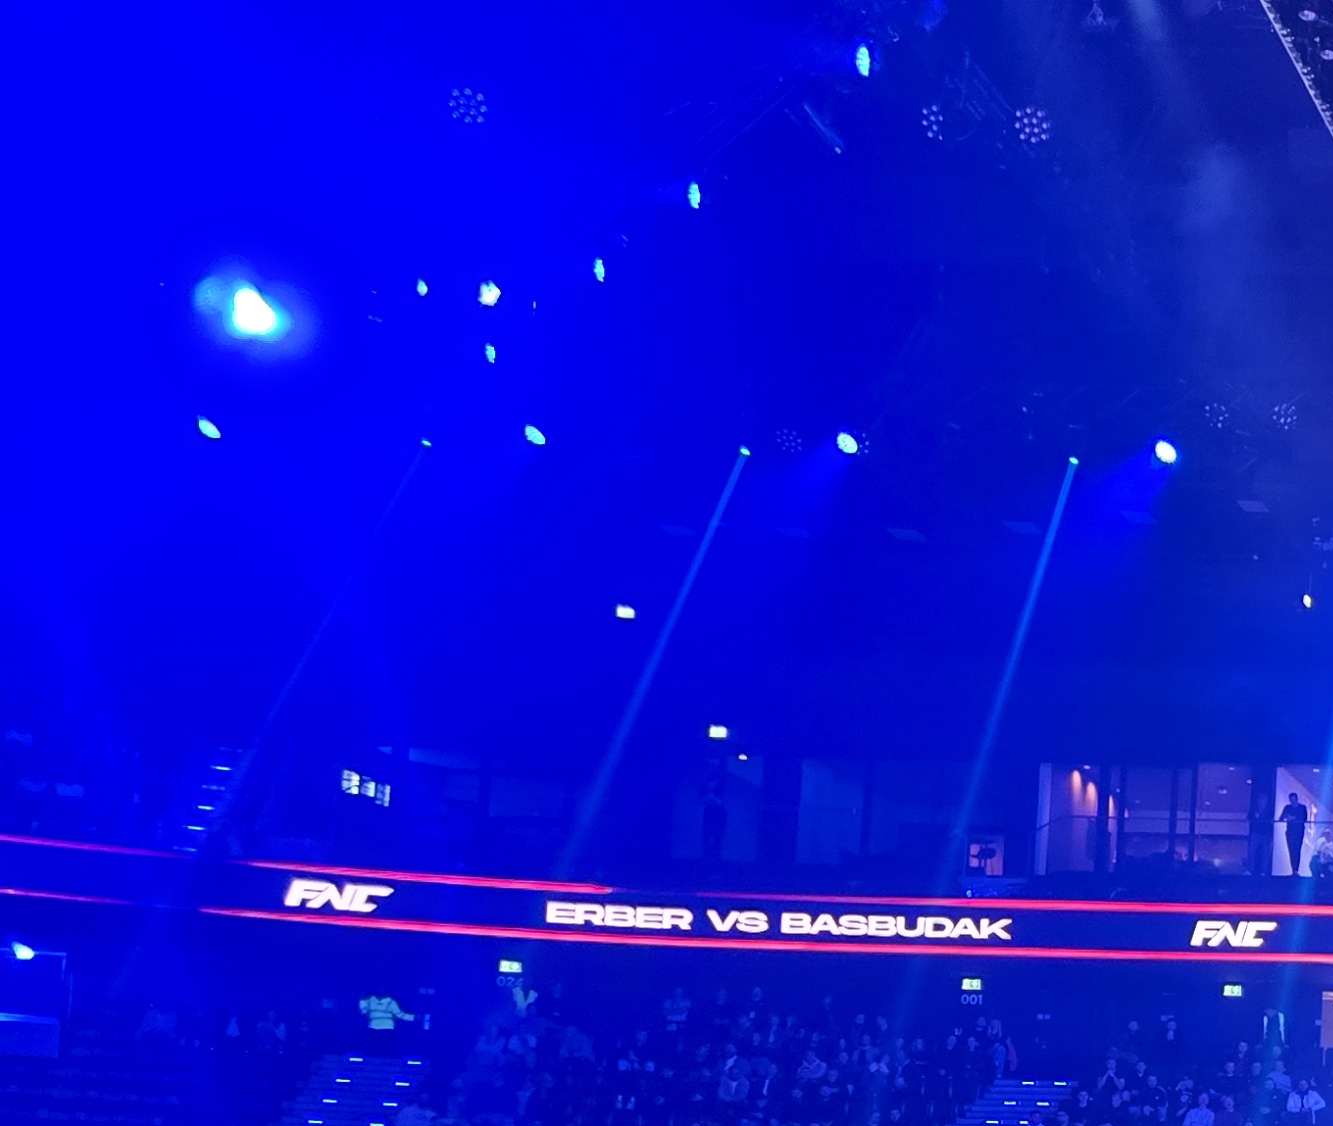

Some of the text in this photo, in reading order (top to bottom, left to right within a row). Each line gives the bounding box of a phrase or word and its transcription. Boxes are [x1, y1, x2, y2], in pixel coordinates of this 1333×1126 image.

[284, 879, 394, 913] FNC
[546, 901, 1013, 940] ERBER VS BASBUDAK
[1190, 920, 1278, 948] FNC
[961, 994, 983, 1006] 001
